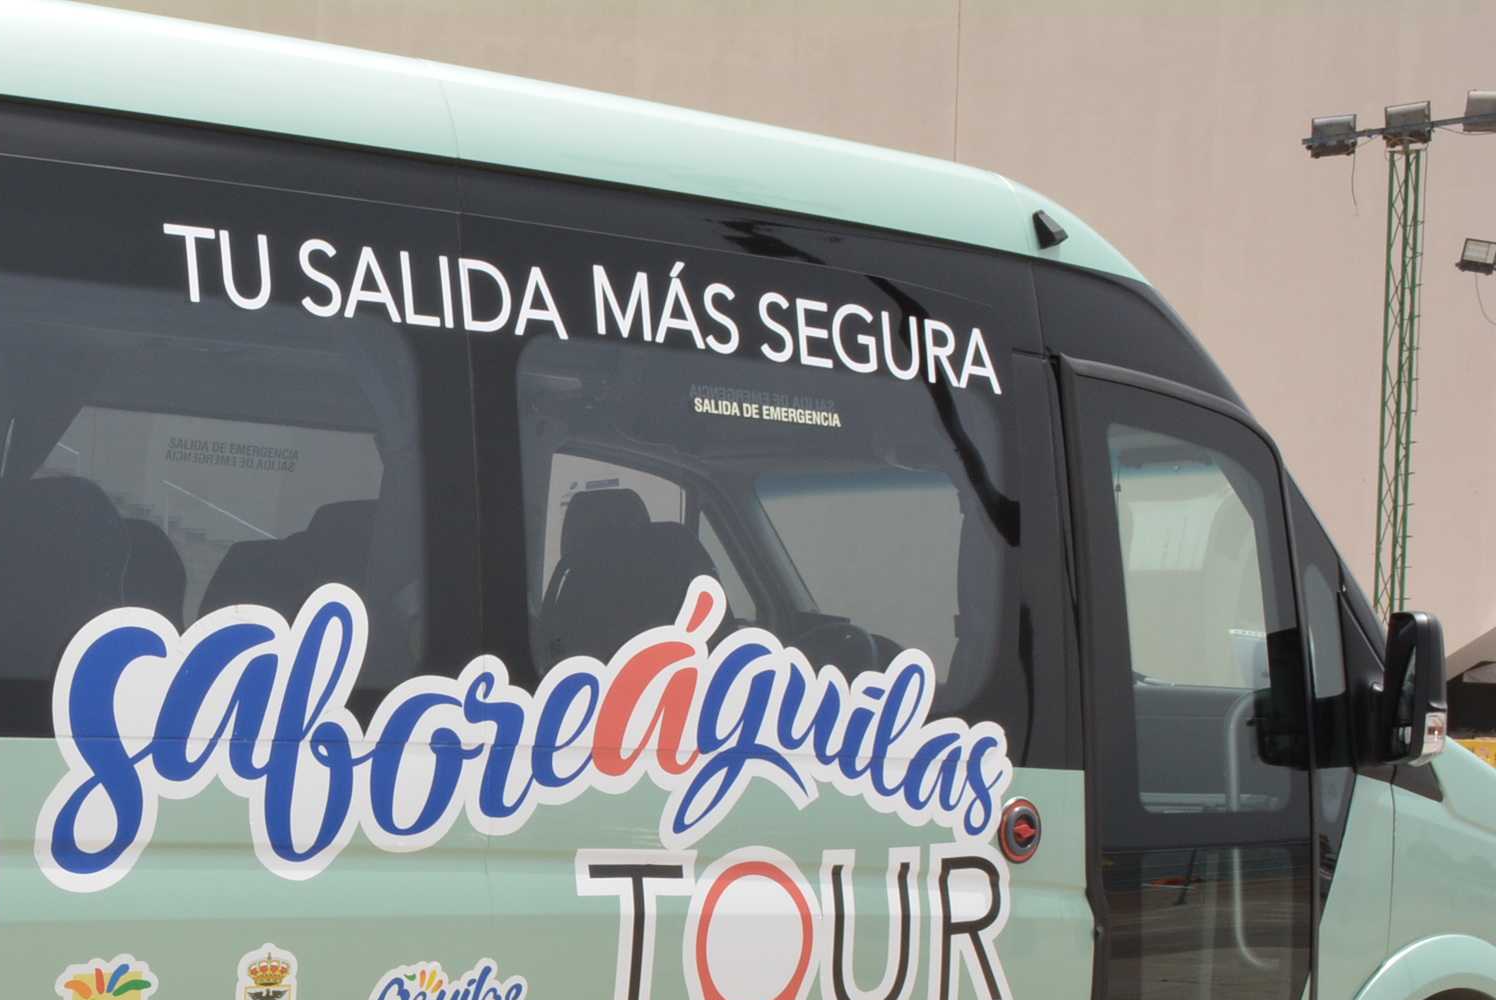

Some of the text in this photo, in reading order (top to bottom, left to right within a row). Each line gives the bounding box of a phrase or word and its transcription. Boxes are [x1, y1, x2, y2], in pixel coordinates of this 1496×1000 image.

[163, 223, 1003, 395] TU SALIDA MÁS SEGURA
[693, 396, 842, 428] SALIDA DE EMERGENCIA
[169, 437, 299, 461] SALIDA DE EMERGENCIA
